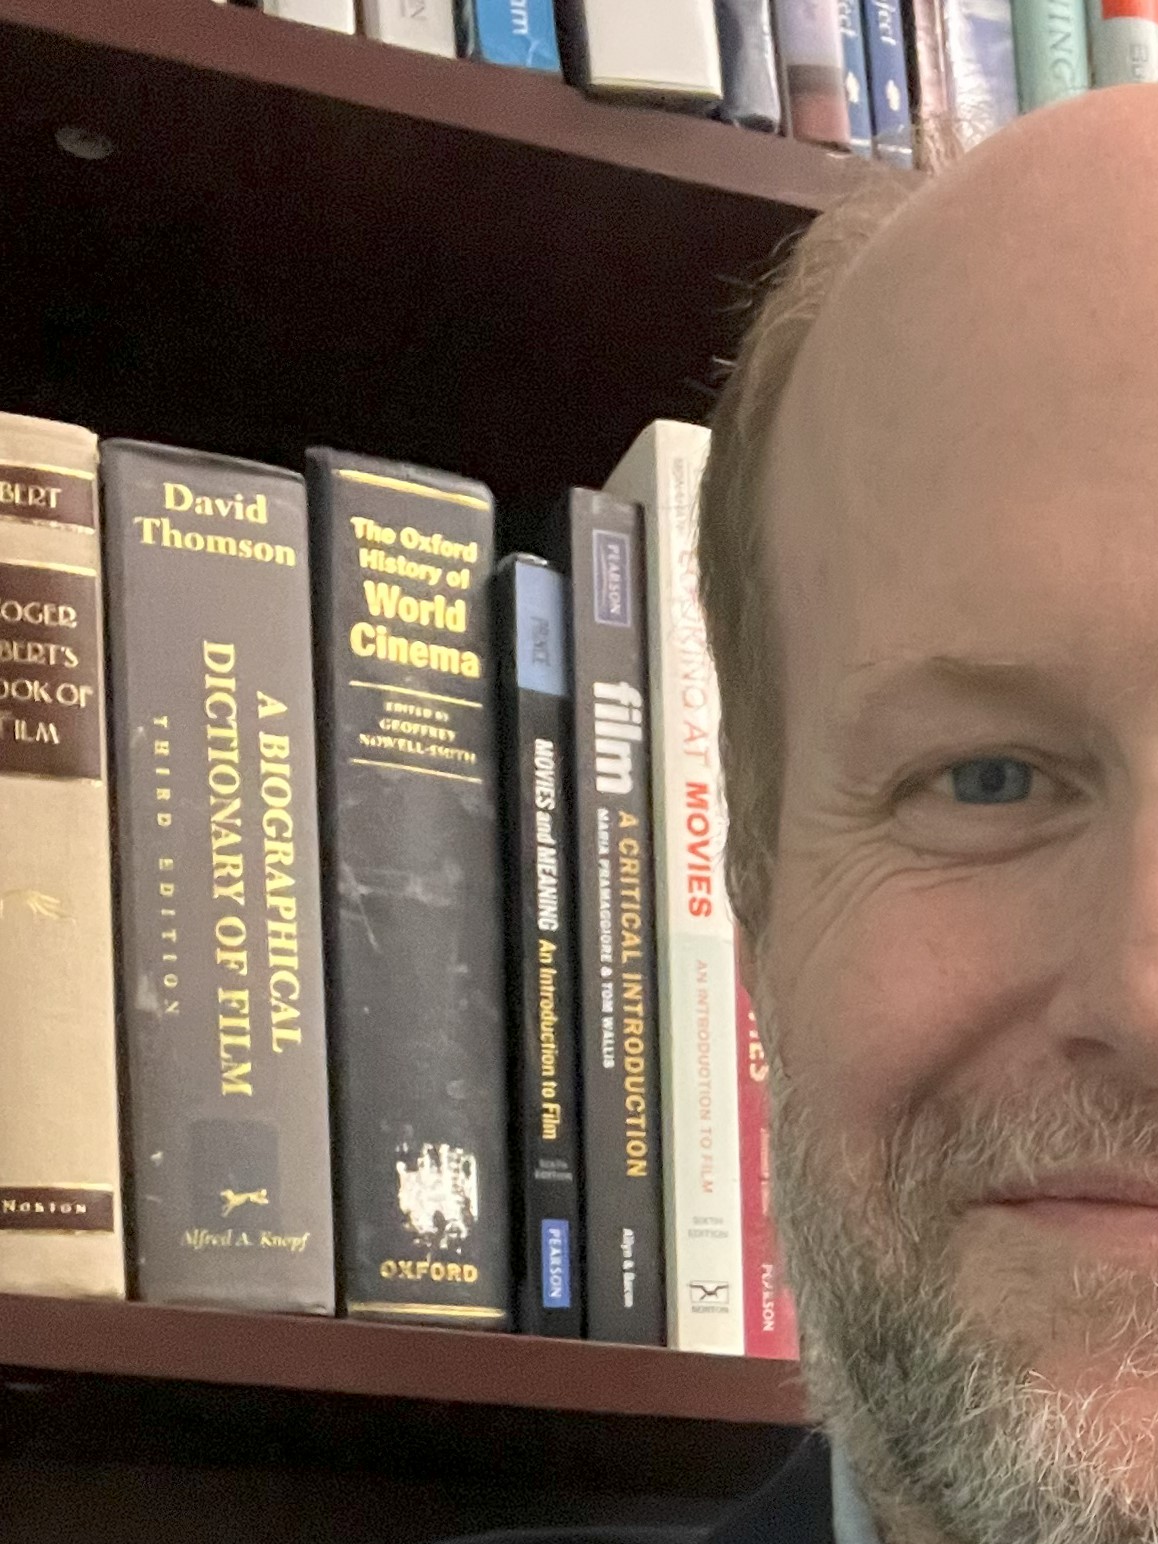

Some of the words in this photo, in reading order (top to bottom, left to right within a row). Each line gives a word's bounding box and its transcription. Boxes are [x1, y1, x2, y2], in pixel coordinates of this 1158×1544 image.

[0, 481, 62, 509] BERT
[163, 481, 268, 525] David
[133, 516, 297, 567] Thomson
[350, 517, 396, 545] The
[400, 527, 478, 564] Oxford
[359, 548, 442, 586] History
[446, 568, 470, 590] of
[607, 543, 622, 615] PEARSON
[0, 600, 77, 628] OGER
[363, 580, 467, 633] World
[0, 640, 79, 668] BERT'S
[350, 622, 480, 679] Cinema
[0, 679, 53, 703] OK
[56, 683, 94, 708] OF
[256, 690, 288, 719] A
[384, 702, 433, 718] EDITED
[358, 733, 477, 765] NOWELL-SMITH
[378, 718, 456, 742] GEOFFREY
[593, 681, 643, 794] film
[683, 720, 710, 767] AT
[153, 715, 172, 827] THIRD
[203, 640, 245, 906] DICTIONARY
[534, 738, 555, 811] MOVIES
[535, 811, 556, 846] and
[596, 807, 610, 856] MARIA
[618, 810, 640, 829] A
[685, 781, 713, 918] MOVIES
[259, 731, 302, 1053] BIOGRAPHICAL
[537, 846, 560, 932] MEANING
[618, 836, 643, 965] CRITICAL
[158, 858, 180, 1014] EDITION
[215, 916, 248, 976] OF
[538, 938, 558, 964] An
[696, 958, 709, 983] AN
[601, 981, 614, 1014] TOM
[218, 987, 253, 1096] FILM
[539, 967, 560, 1076] Introduction
[602, 1016, 616, 1069] WALLIS
[621, 972, 649, 1178] INTRODUCTION
[697, 990, 712, 1121] INTRODUCTION
[541, 1082, 558, 1098] to
[541, 1103, 561, 1139] Film
[699, 1125, 713, 1150] TO
[702, 1153, 715, 1195] FILM
[182, 1229, 232, 1250] Alfred
[260, 1230, 311, 1252] Knopf
[548, 1228, 562, 1298] PEARSON
[380, 1260, 478, 1283] OXFORD
